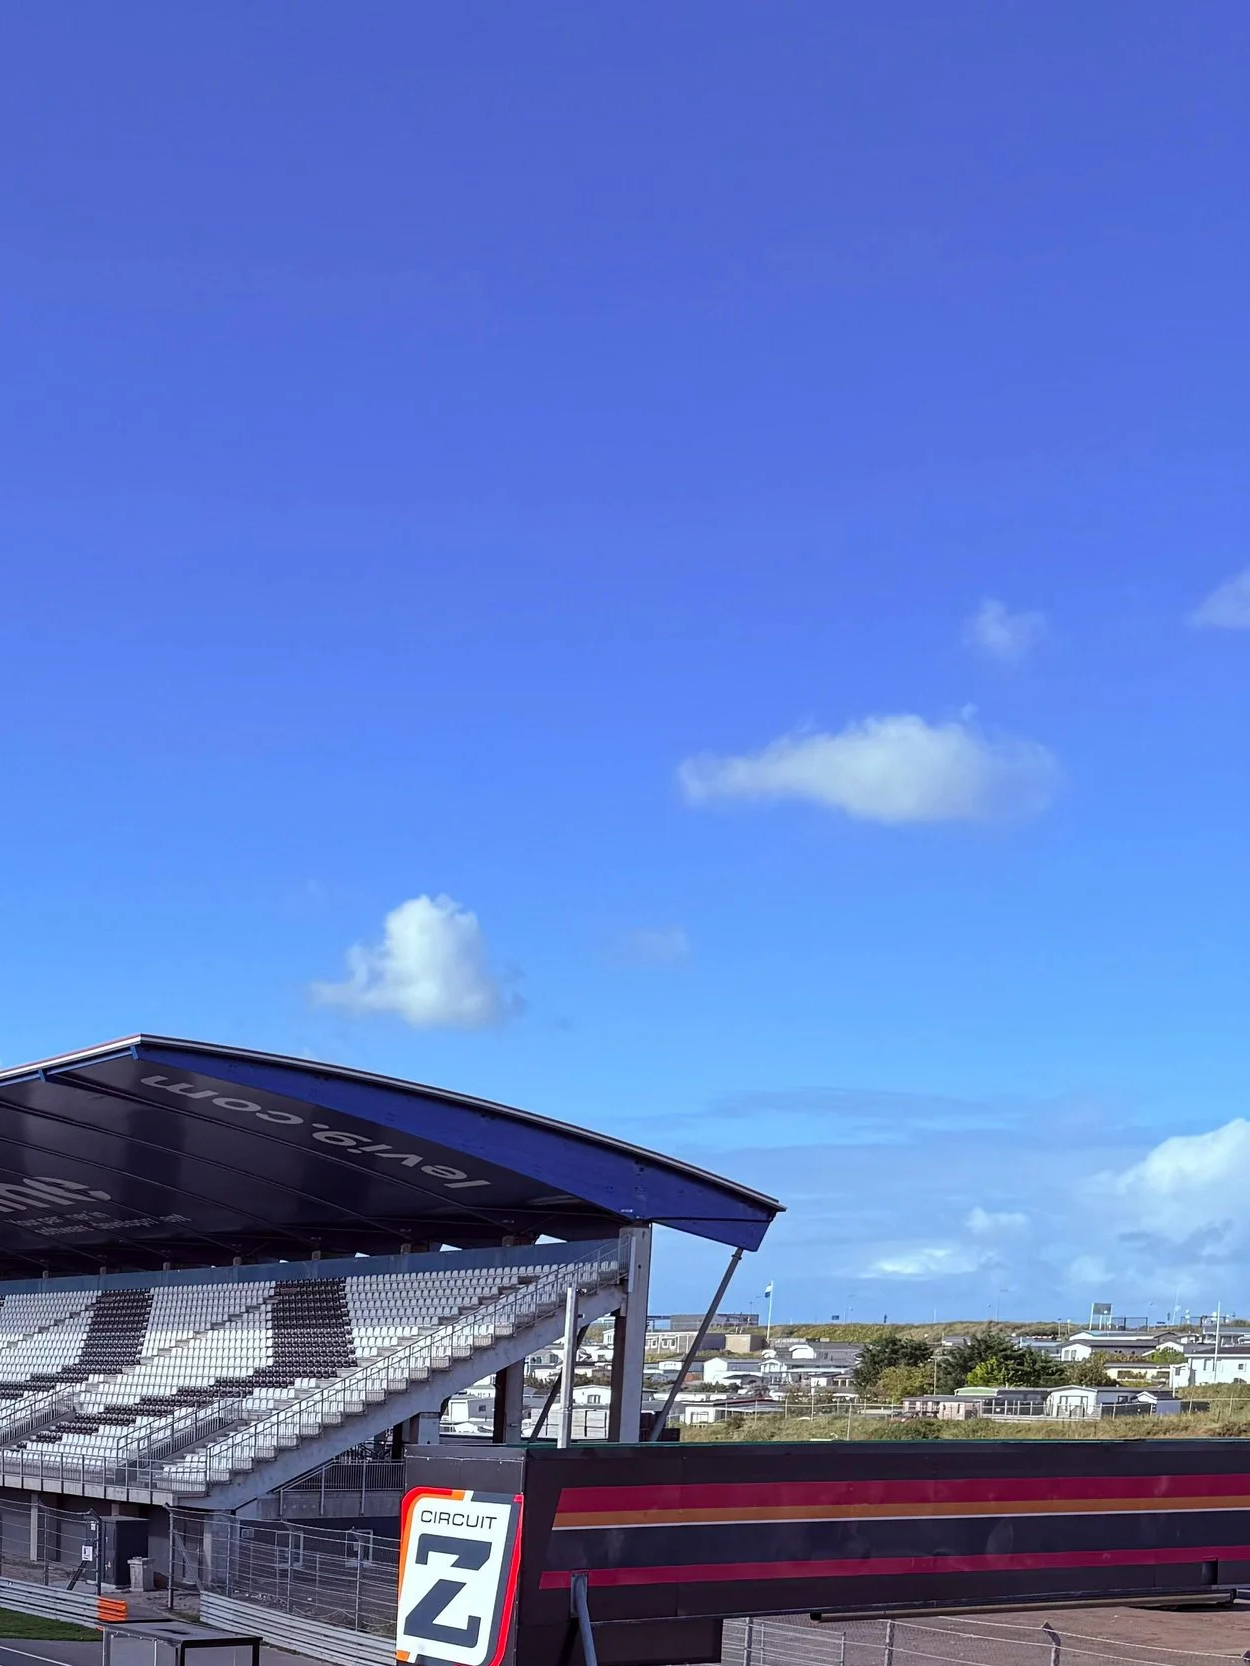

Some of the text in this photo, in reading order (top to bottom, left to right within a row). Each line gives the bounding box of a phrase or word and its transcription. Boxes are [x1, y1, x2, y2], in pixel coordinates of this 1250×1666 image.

[139, 1075, 492, 1190] levi9.com
[420, 1510, 498, 1530] CIRCUIT
[403, 1533, 493, 1649] Z
